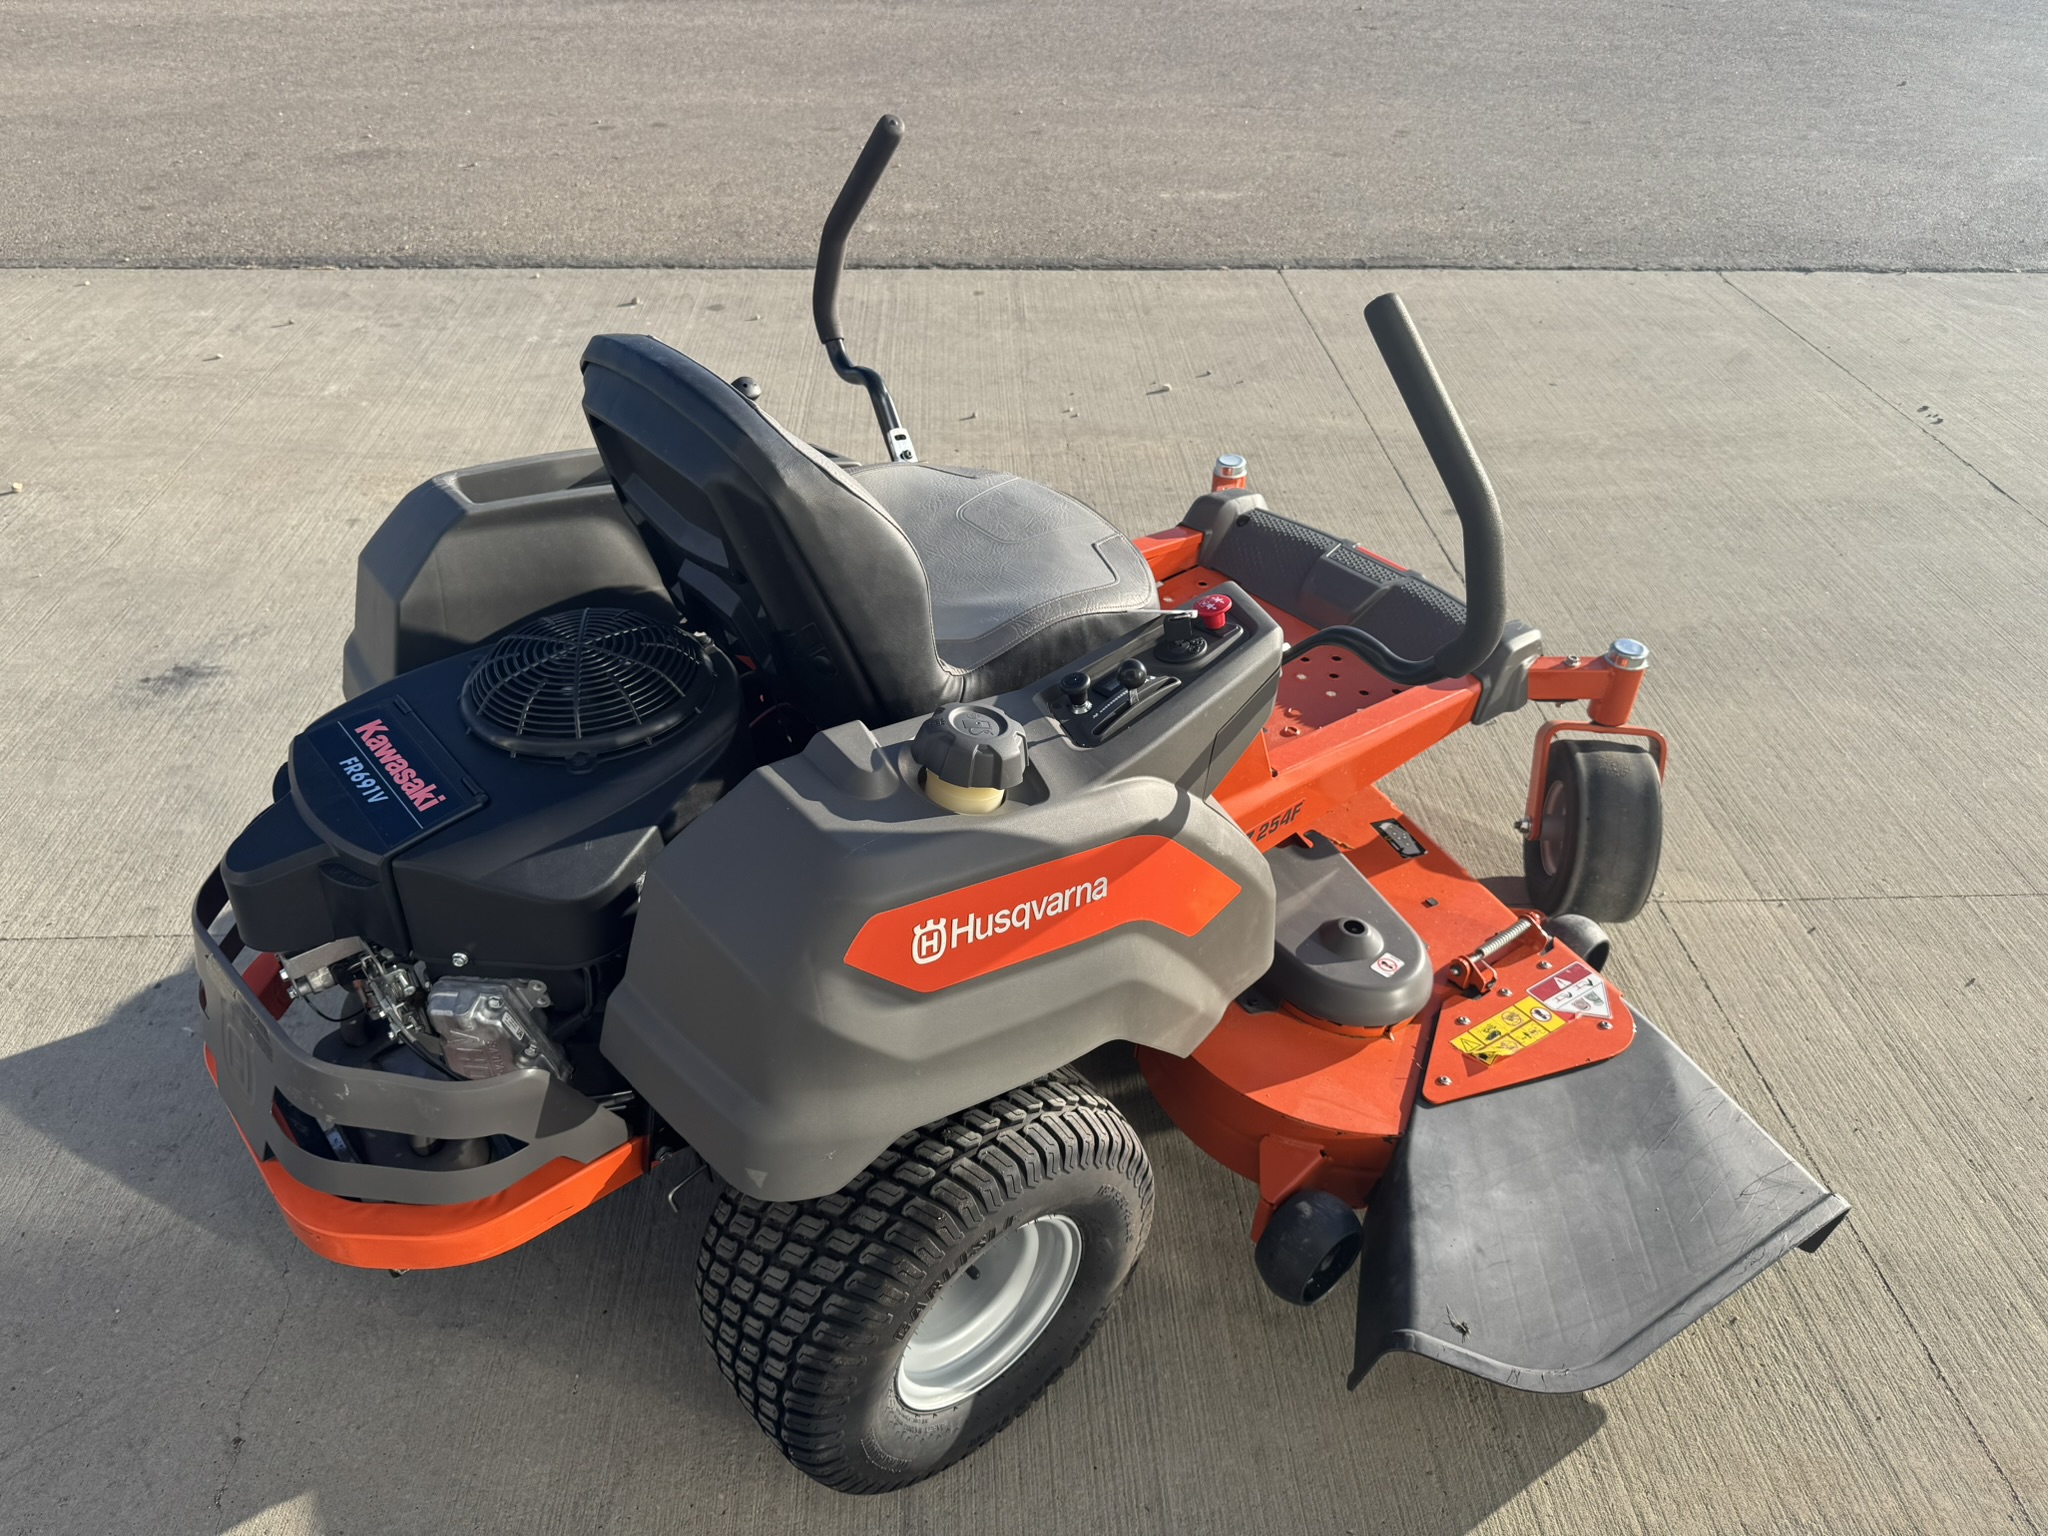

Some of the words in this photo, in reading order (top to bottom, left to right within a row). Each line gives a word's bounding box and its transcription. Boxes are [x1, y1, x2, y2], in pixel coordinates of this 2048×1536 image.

[338, 755, 390, 804] FR691V
[354, 718, 447, 813] Kawasaki
[1256, 801, 1304, 842] 254F
[950, 876, 1108, 949] Husqvarna
